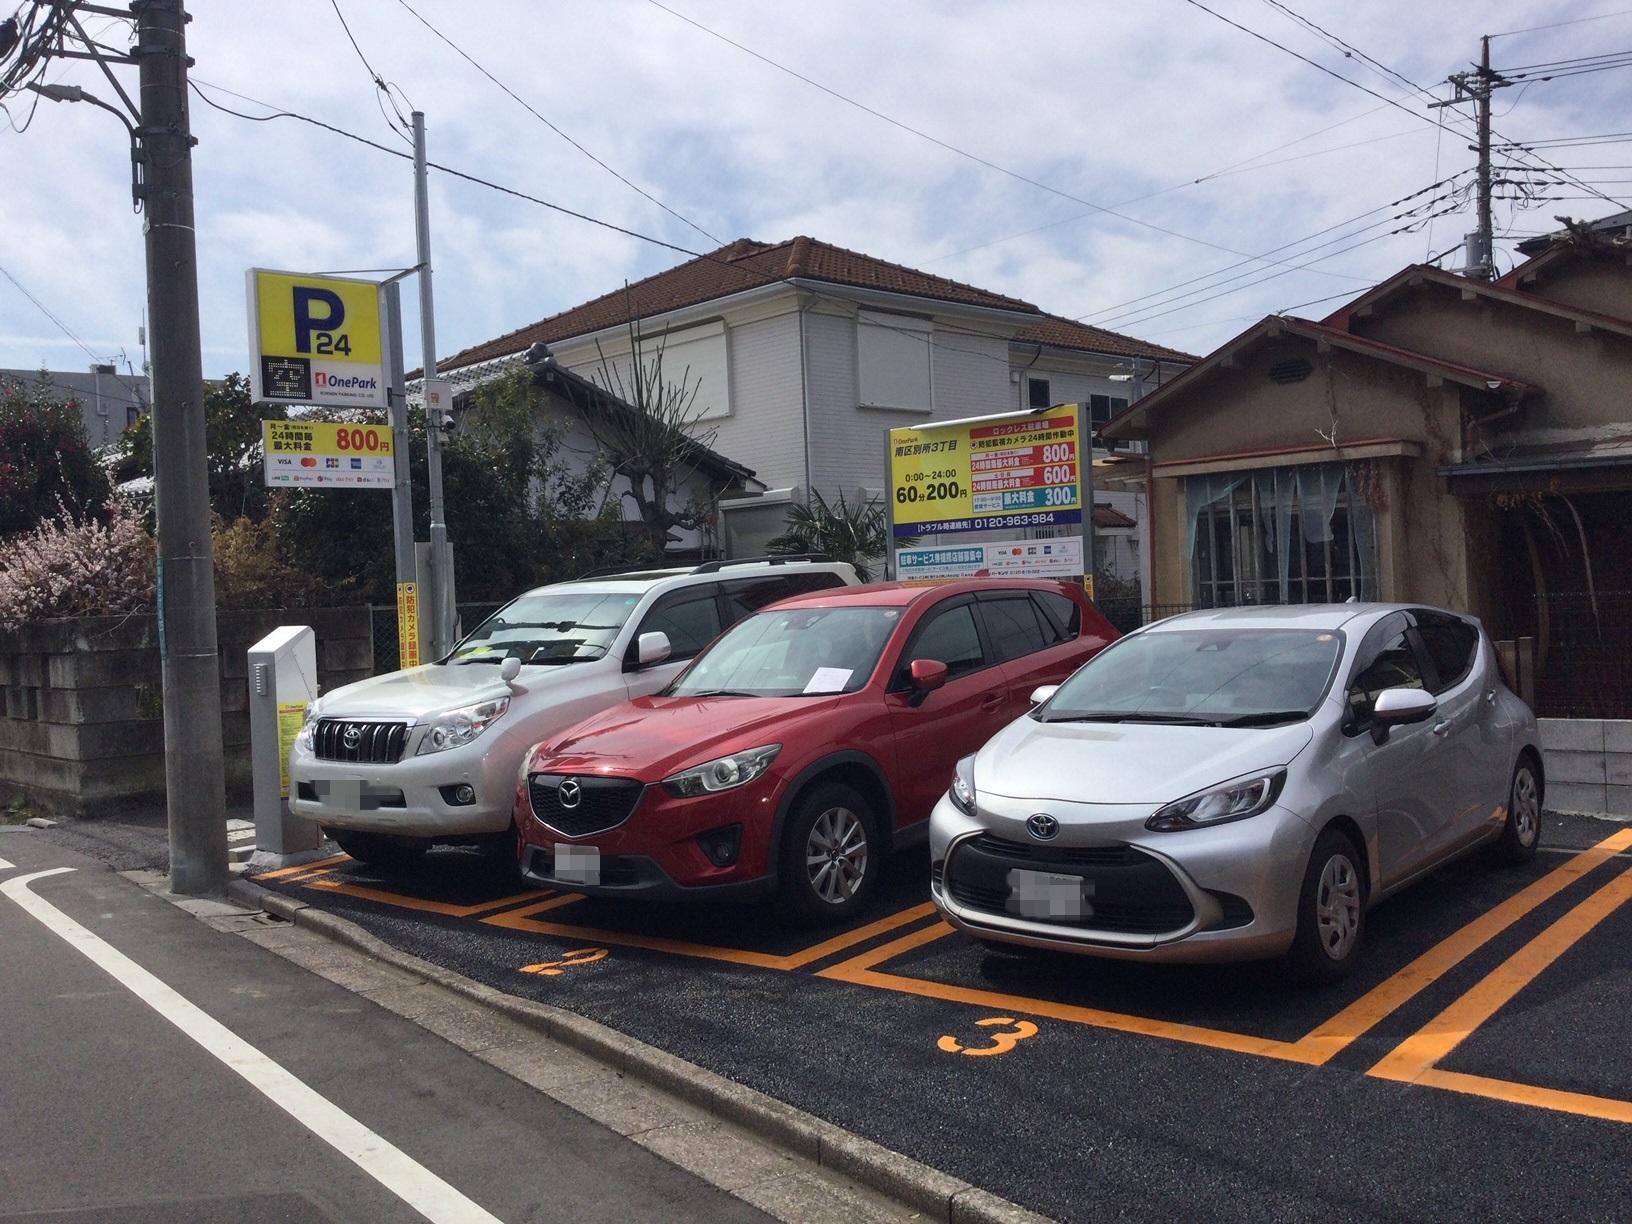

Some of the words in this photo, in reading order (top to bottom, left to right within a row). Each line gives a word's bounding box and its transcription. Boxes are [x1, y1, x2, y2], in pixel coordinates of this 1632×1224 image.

[293, 286, 345, 353] P
[316, 333, 352, 356] 24
[268, 359, 306, 397] 空
[328, 375, 377, 389] OnePark
[273, 441, 312, 451] 最大料金
[336, 428, 390, 452] 800円
[894, 440, 958, 457] 南区別所3丁目
[1043, 443, 1075, 463] 800円
[1043, 465, 1076, 484] 600円
[1004, 490, 1035, 505] 最大料金
[1045, 486, 1077, 505] 300円
[974, 513, 1055, 529] 0120-963-984
[406, 595, 417, 667] 防犯カメラ録画中
[519, 947, 609, 976] 2
[937, 1017, 1039, 1056] 3
